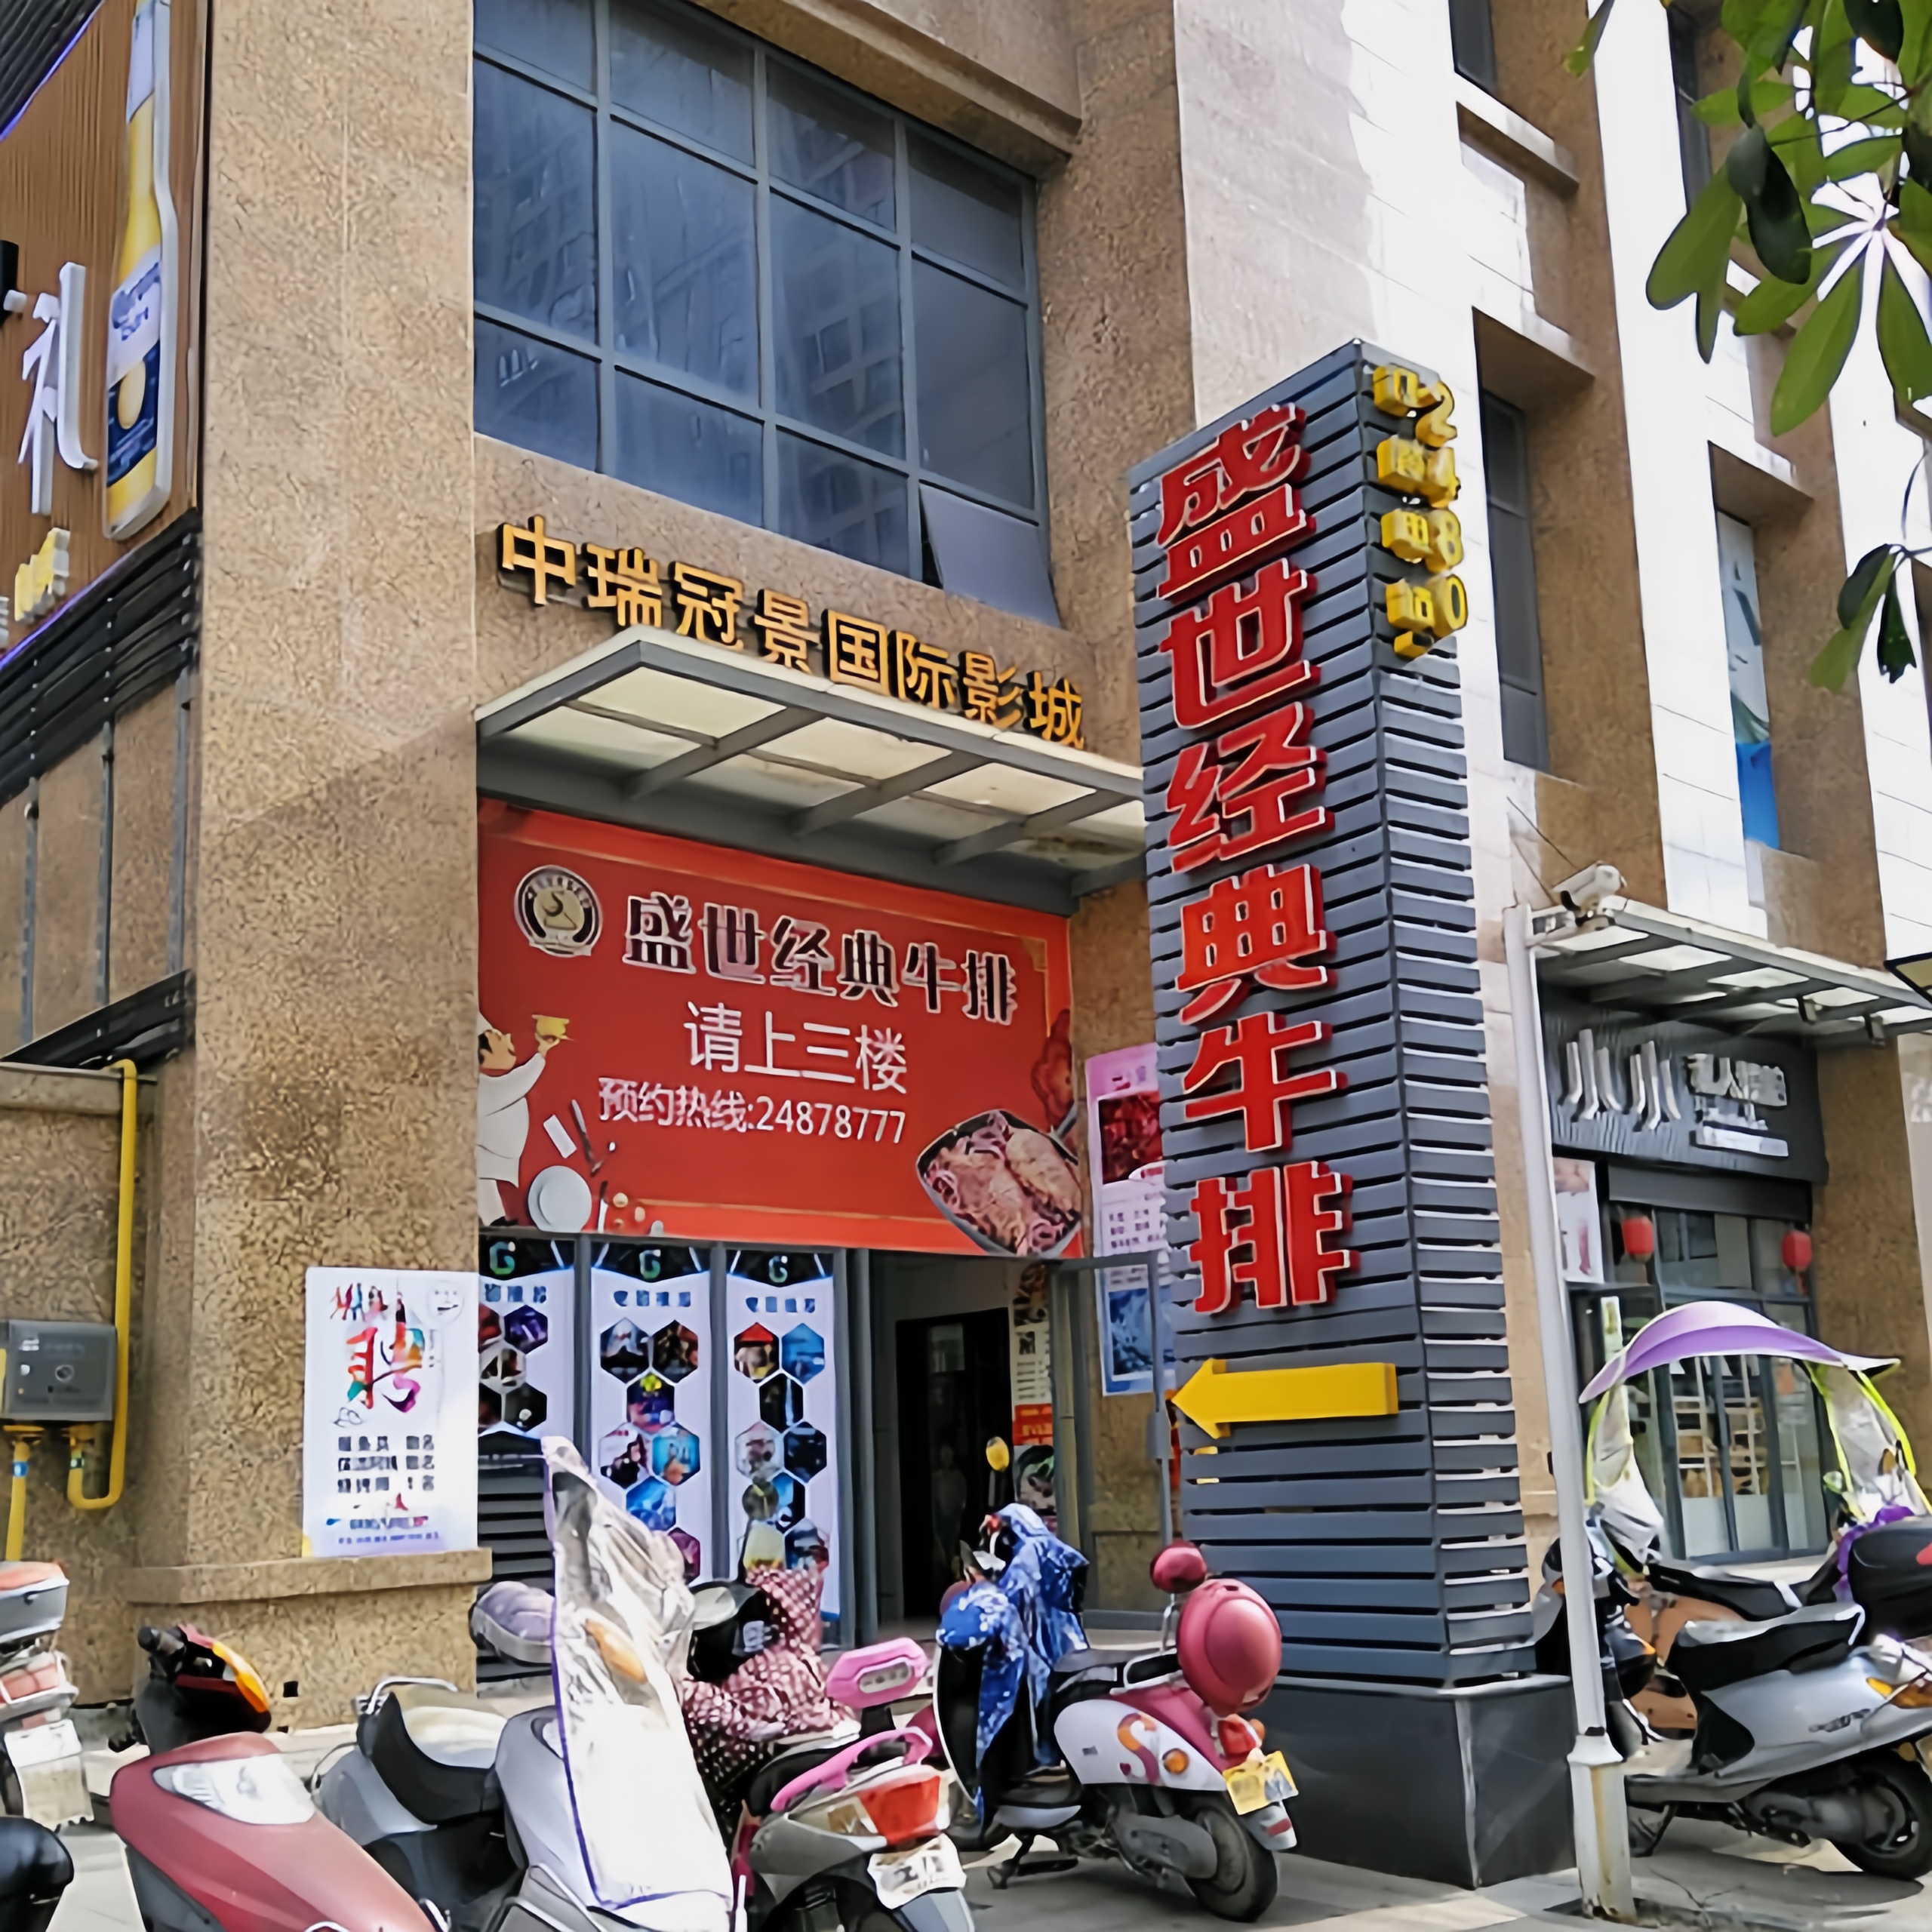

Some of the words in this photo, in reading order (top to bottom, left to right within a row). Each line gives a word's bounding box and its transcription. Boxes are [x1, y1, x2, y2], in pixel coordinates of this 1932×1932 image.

[497, 515, 1084, 749] 中瑞冠景国际影城
[1157, 402, 1358, 1315] 盛世经典牛排
[622, 891, 1017, 1026] 盛世经典牛排
[598, 1076, 907, 1144] 预约热线:24878777
[683, 1001, 907, 1094] 请上三楼
